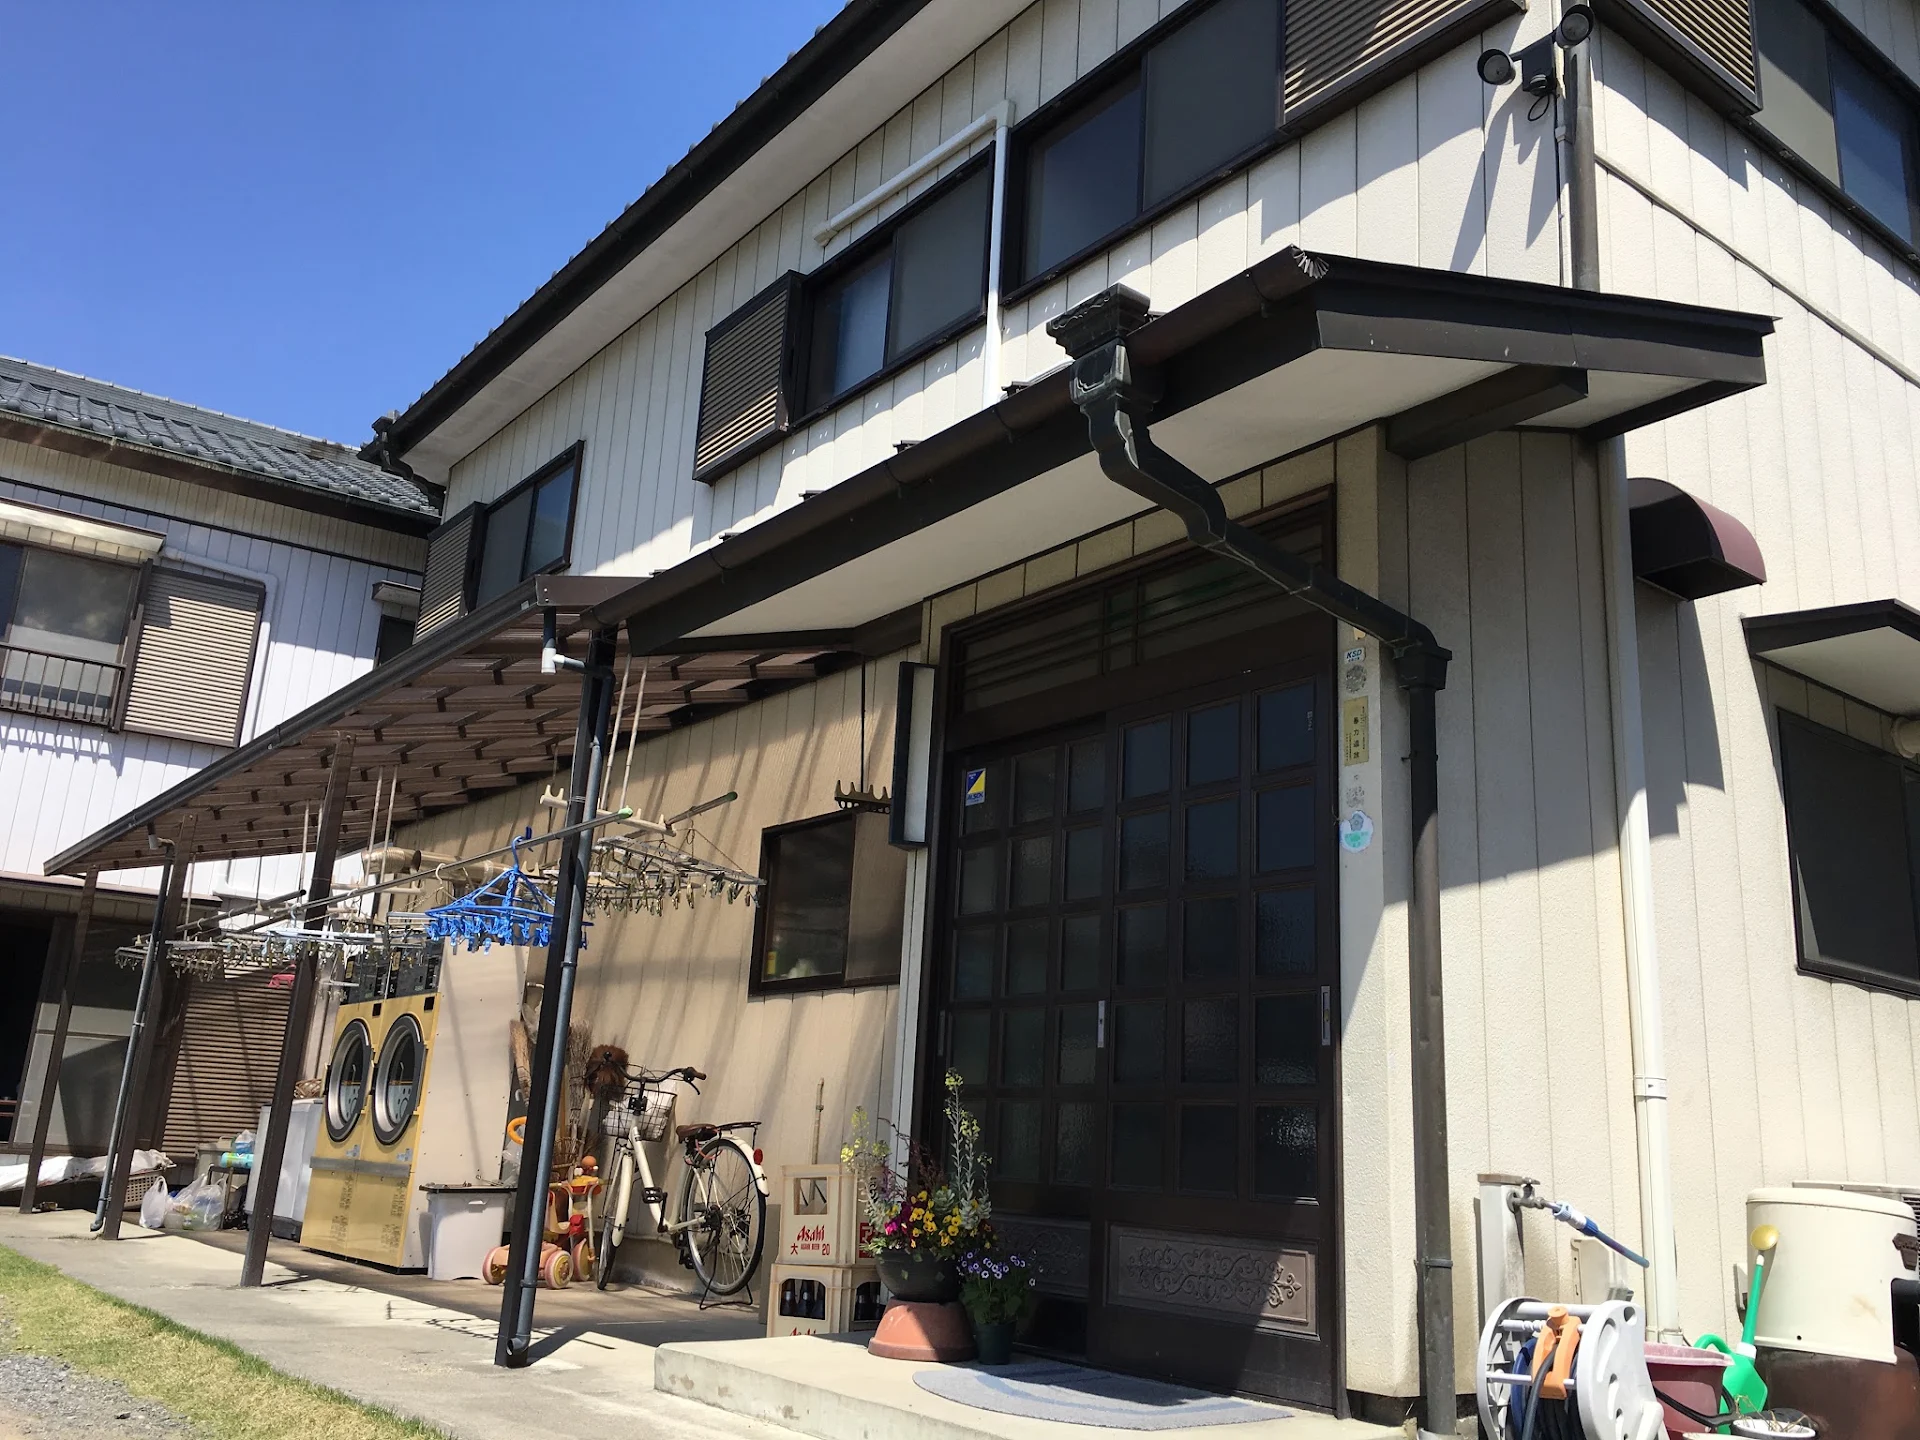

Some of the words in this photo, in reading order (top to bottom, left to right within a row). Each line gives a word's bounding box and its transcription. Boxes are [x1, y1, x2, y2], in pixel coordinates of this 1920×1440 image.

[1346, 649, 1362, 659] KSD
[797, 1224, 825, 1242] Asahi
[790, 1243, 799, 1255] 大
[822, 1243, 831, 1256] 20
